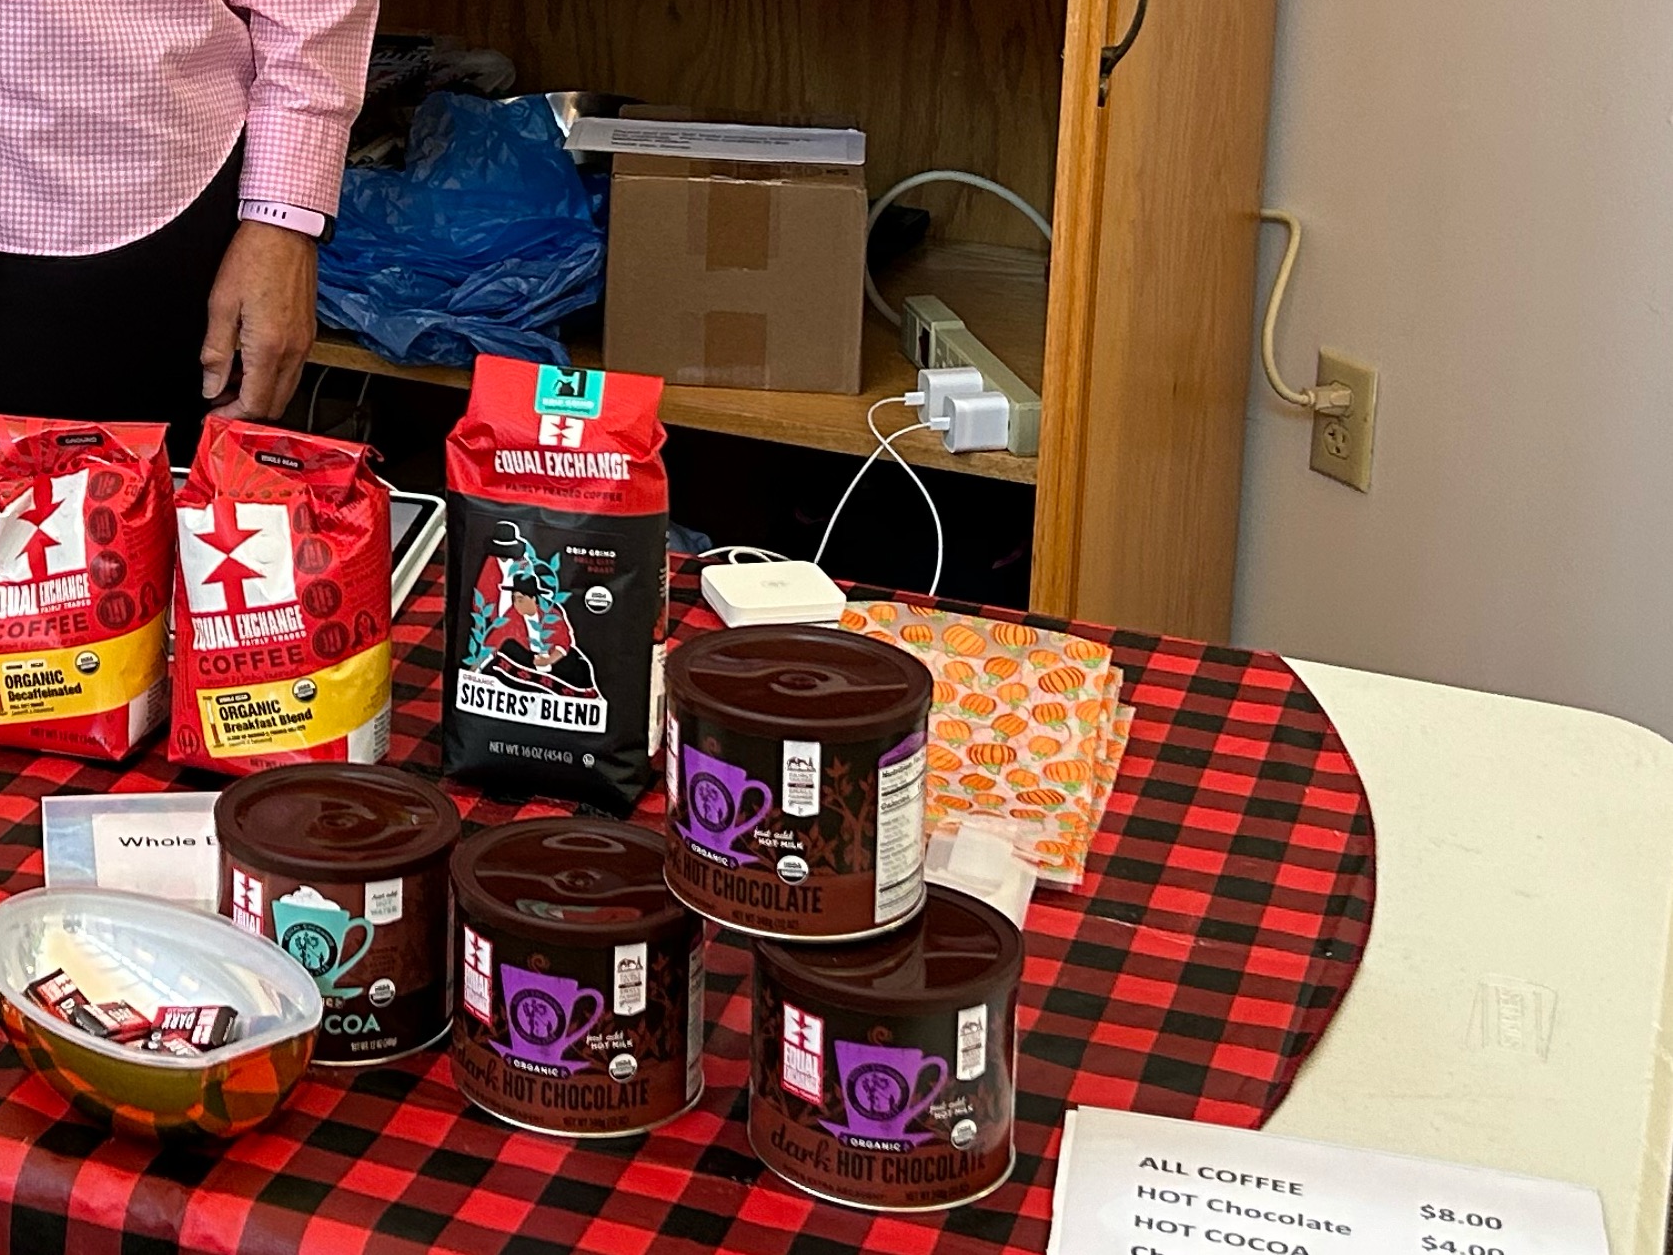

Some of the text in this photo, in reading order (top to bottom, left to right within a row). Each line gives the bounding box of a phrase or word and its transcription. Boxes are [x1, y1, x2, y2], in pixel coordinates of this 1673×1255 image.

[494, 450, 631, 480] EQUAL EXCHANGE
[589, 548, 616, 557] GRIND
[39, 573, 90, 607] EXCHANGE
[235, 605, 305, 639] EXCHANGE
[199, 644, 304, 675] COFFEE
[5, 670, 64, 689] ORGANIC
[462, 674, 495, 687] ORGANIC
[7, 683, 83, 702] Decaffeinated
[460, 683, 601, 726] SISTERS' BLEND
[219, 700, 281, 721] ORGANIC
[223, 708, 313, 733] Breakfast Blend
[489, 741, 574, 764] NET 16 OZ (454 G)
[119, 835, 197, 848] Whole
[691, 843, 728, 867] ORGANIC
[683, 853, 823, 914] HOT CHOCOLATE
[162, 1013, 196, 1030] DARK
[325, 1013, 381, 1035] COA
[513, 1059, 559, 1076] ORGANIC
[784, 1049, 819, 1076] EQUAL
[457, 1047, 649, 1111] dark HOT CHOCOLATE
[771, 1129, 985, 1185] dark HOT CHOCOLATE
[849, 1137, 902, 1152] ORGANIC
[1138, 1156, 1304, 1197] ALL COFFEE
[1136, 1185, 1503, 1237] HOT Chocolate $8.00
[1133, 1214, 1505, 1255] HOT COCOA $4.00
